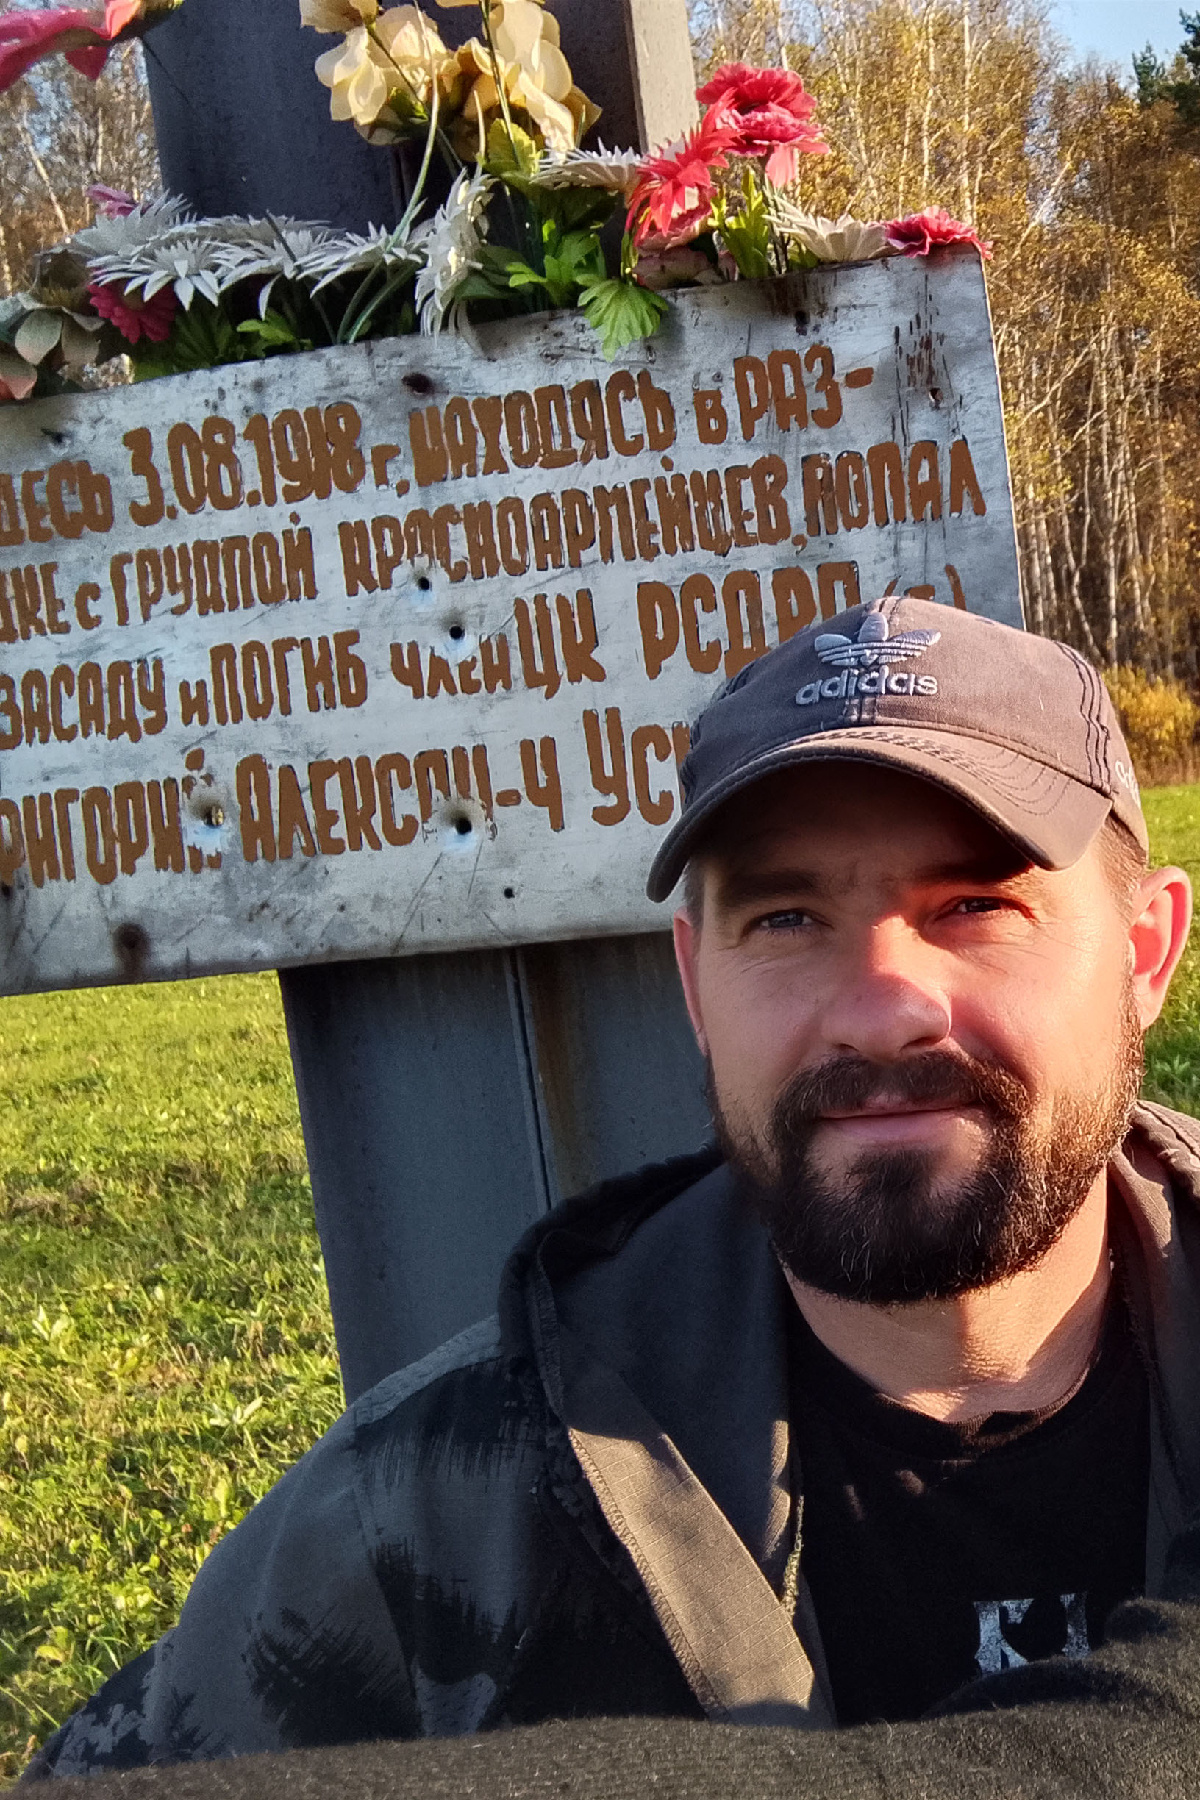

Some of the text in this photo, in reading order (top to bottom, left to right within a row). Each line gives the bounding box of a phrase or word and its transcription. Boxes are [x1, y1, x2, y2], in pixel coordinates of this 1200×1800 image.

[409, 369, 677, 487] НАХОДЯСЬ
[733, 344, 875, 441] РАЗ-
[110, 511, 318, 626] ГРУППОЙ
[801, 434, 986, 537] ПОПАЛ
[0, 656, 168, 750] ЗАСАДУ
[209, 629, 368, 726] ПОГИБ
[514, 588, 607, 700] ЦК
[796, 665, 938, 705] adidas
